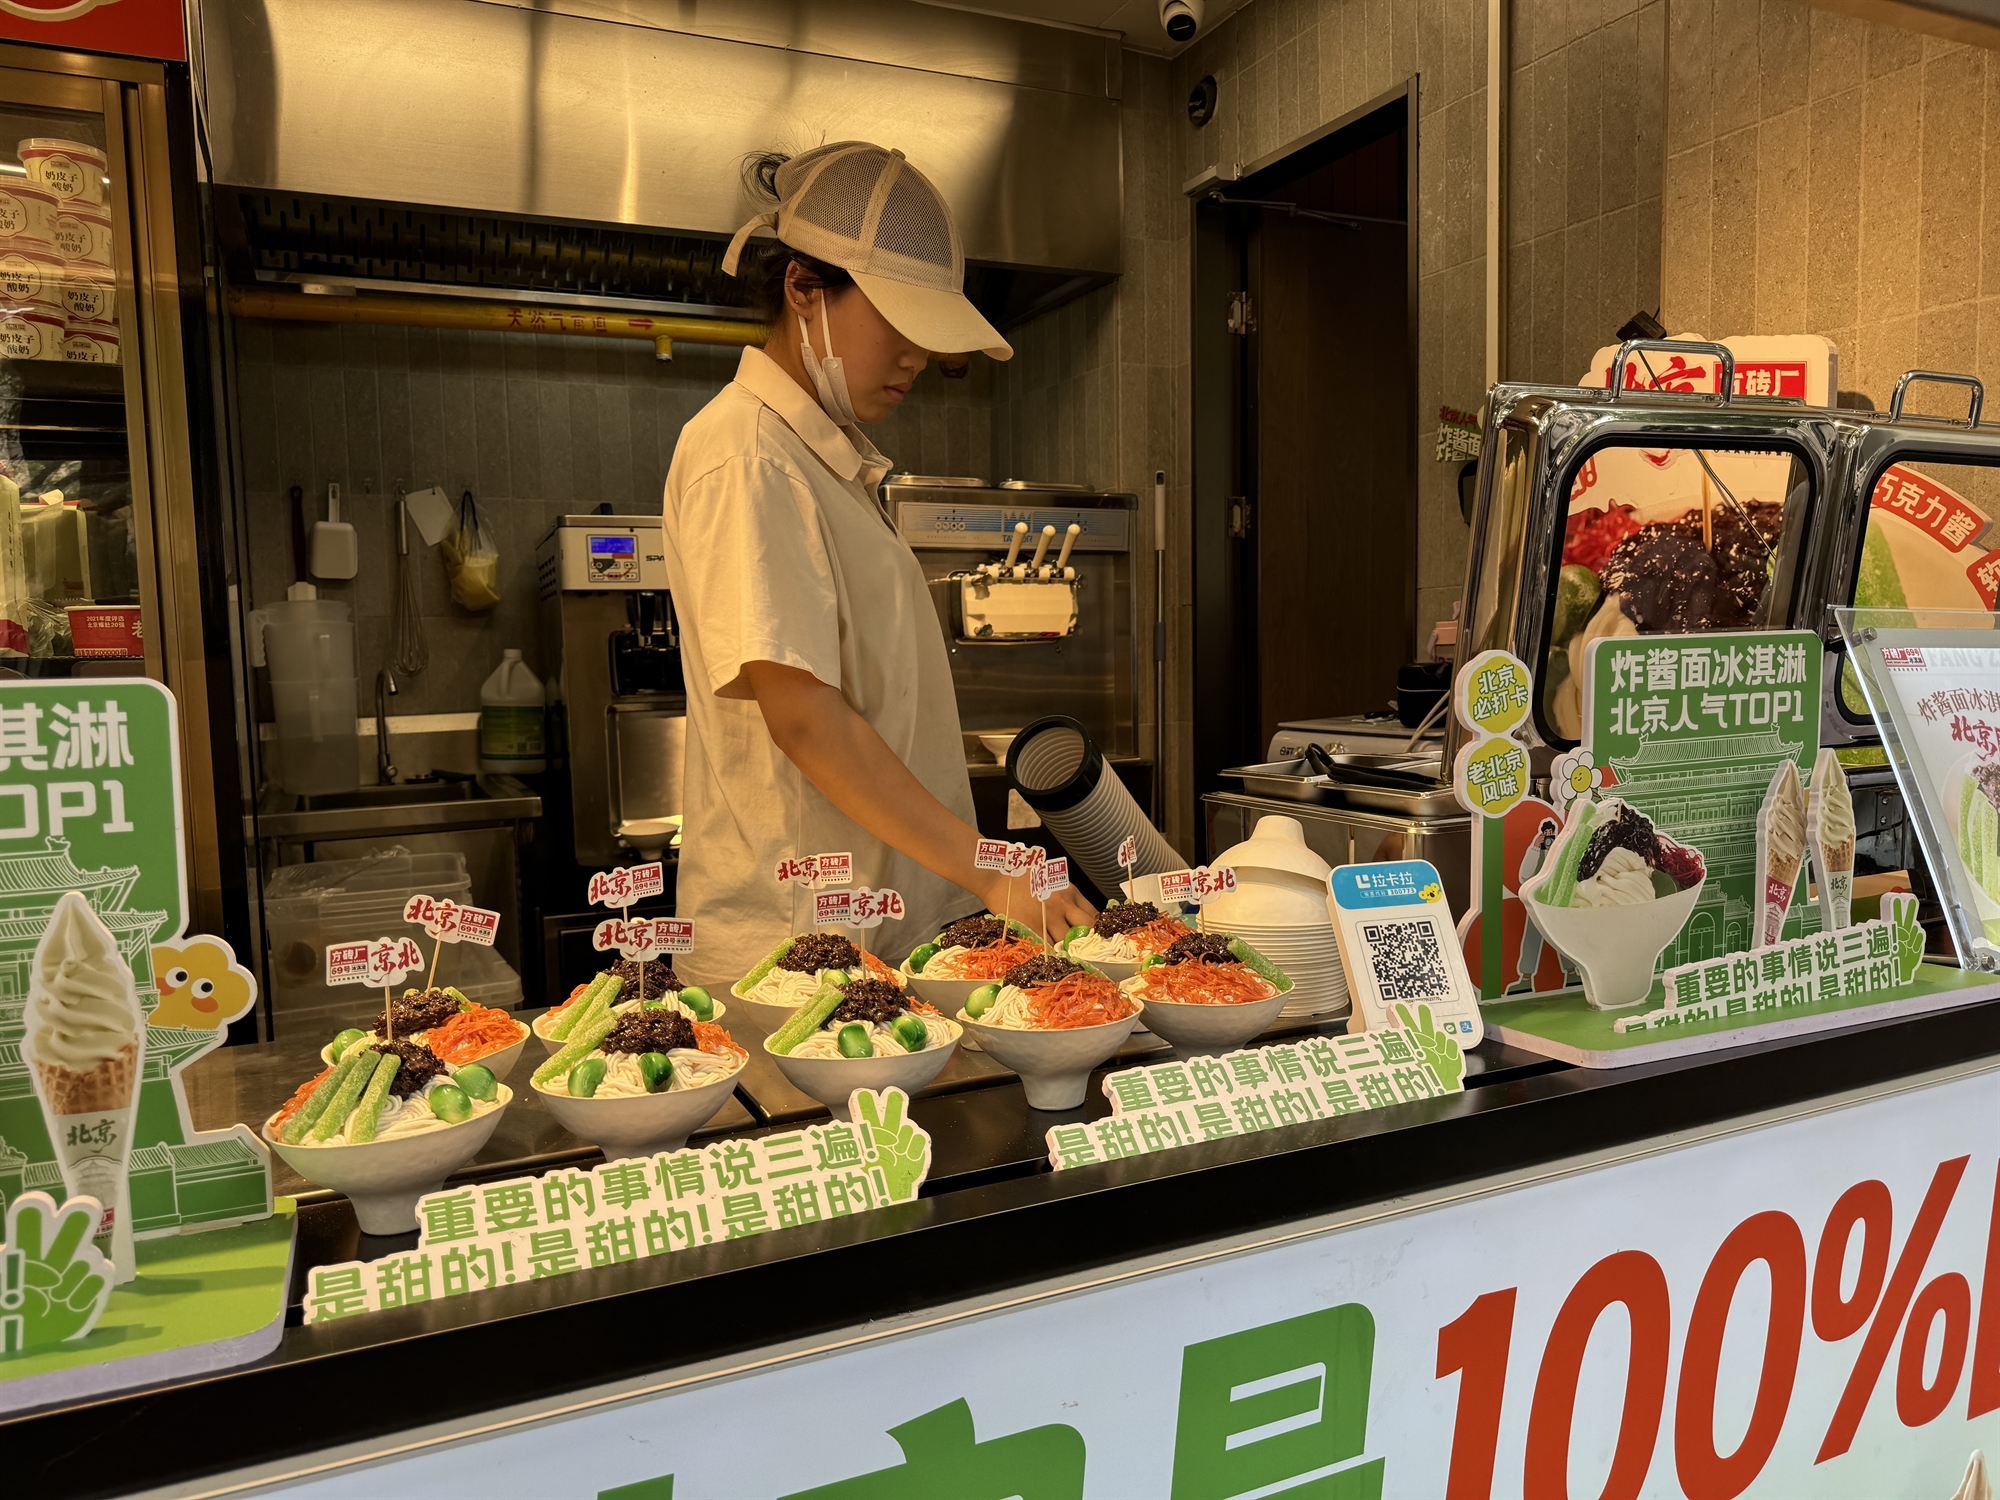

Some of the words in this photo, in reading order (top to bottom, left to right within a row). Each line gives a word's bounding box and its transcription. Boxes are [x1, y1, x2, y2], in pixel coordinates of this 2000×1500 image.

[45, 170, 78, 183] 奶皮子
[6, 282, 30, 294] 酸奶
[67, 291, 99, 302] 奶皮子
[73, 302, 95, 313] 酸奶
[6, 344, 30, 356] 酸奶
[66, 350, 99, 362] 奶皮子
[1436, 423, 1482, 457] 炸酱面
[1477, 664, 1518, 695] 北京
[1610, 642, 1807, 694] 炸酱面冰淇淋
[1472, 684, 1529, 722] 必打卡
[1609, 689, 1804, 736] 北京人气TOP1
[1949, 714, 1999, 761] 北京
[1466, 748, 1525, 786] 老北京
[1480, 775, 1519, 807] 风味
[821, 857, 848, 867] 方砖厂
[981, 843, 1006, 854] 方砖厂
[633, 867, 659, 881] 方砖厂
[777, 857, 820, 886] 北京
[1162, 874, 1189, 886] 方砖厂
[1192, 868, 1235, 901] 京北
[1371, 871, 1415, 888] 拉卡拉
[1830, 876, 1848, 895] 北京
[590, 870, 632, 906] 北京
[634, 882, 649, 891] 69号
[818, 895, 848, 907] 方砖厂
[1768, 883, 1788, 903] 北京
[406, 898, 459, 936] 北京
[462, 911, 495, 925] 方砖厂
[818, 909, 835, 917] 69号
[852, 892, 903, 926] 京北
[460, 924, 478, 934] 69号
[598, 920, 653, 958] 北京
[657, 922, 690, 934] 方砖厂
[331, 965, 351, 975] 69号
[332, 948, 366, 963] 方砖厂
[370, 940, 420, 983] 京北
[1673, 923, 1899, 1008] 重要的事情说三遍!
[1110, 1028, 1424, 1113] 重要的事情说三遍!
[1053, 1064, 1446, 1170] 是甜的!是甜的!是甜的!
[66, 1119, 117, 1152] 北京
[420, 1122, 878, 1246] 重要的事情说三遍!
[309, 1169, 890, 1324] 是甜的!是甜的!是甜的!
[1434, 1154, 1972, 1500] 100%
